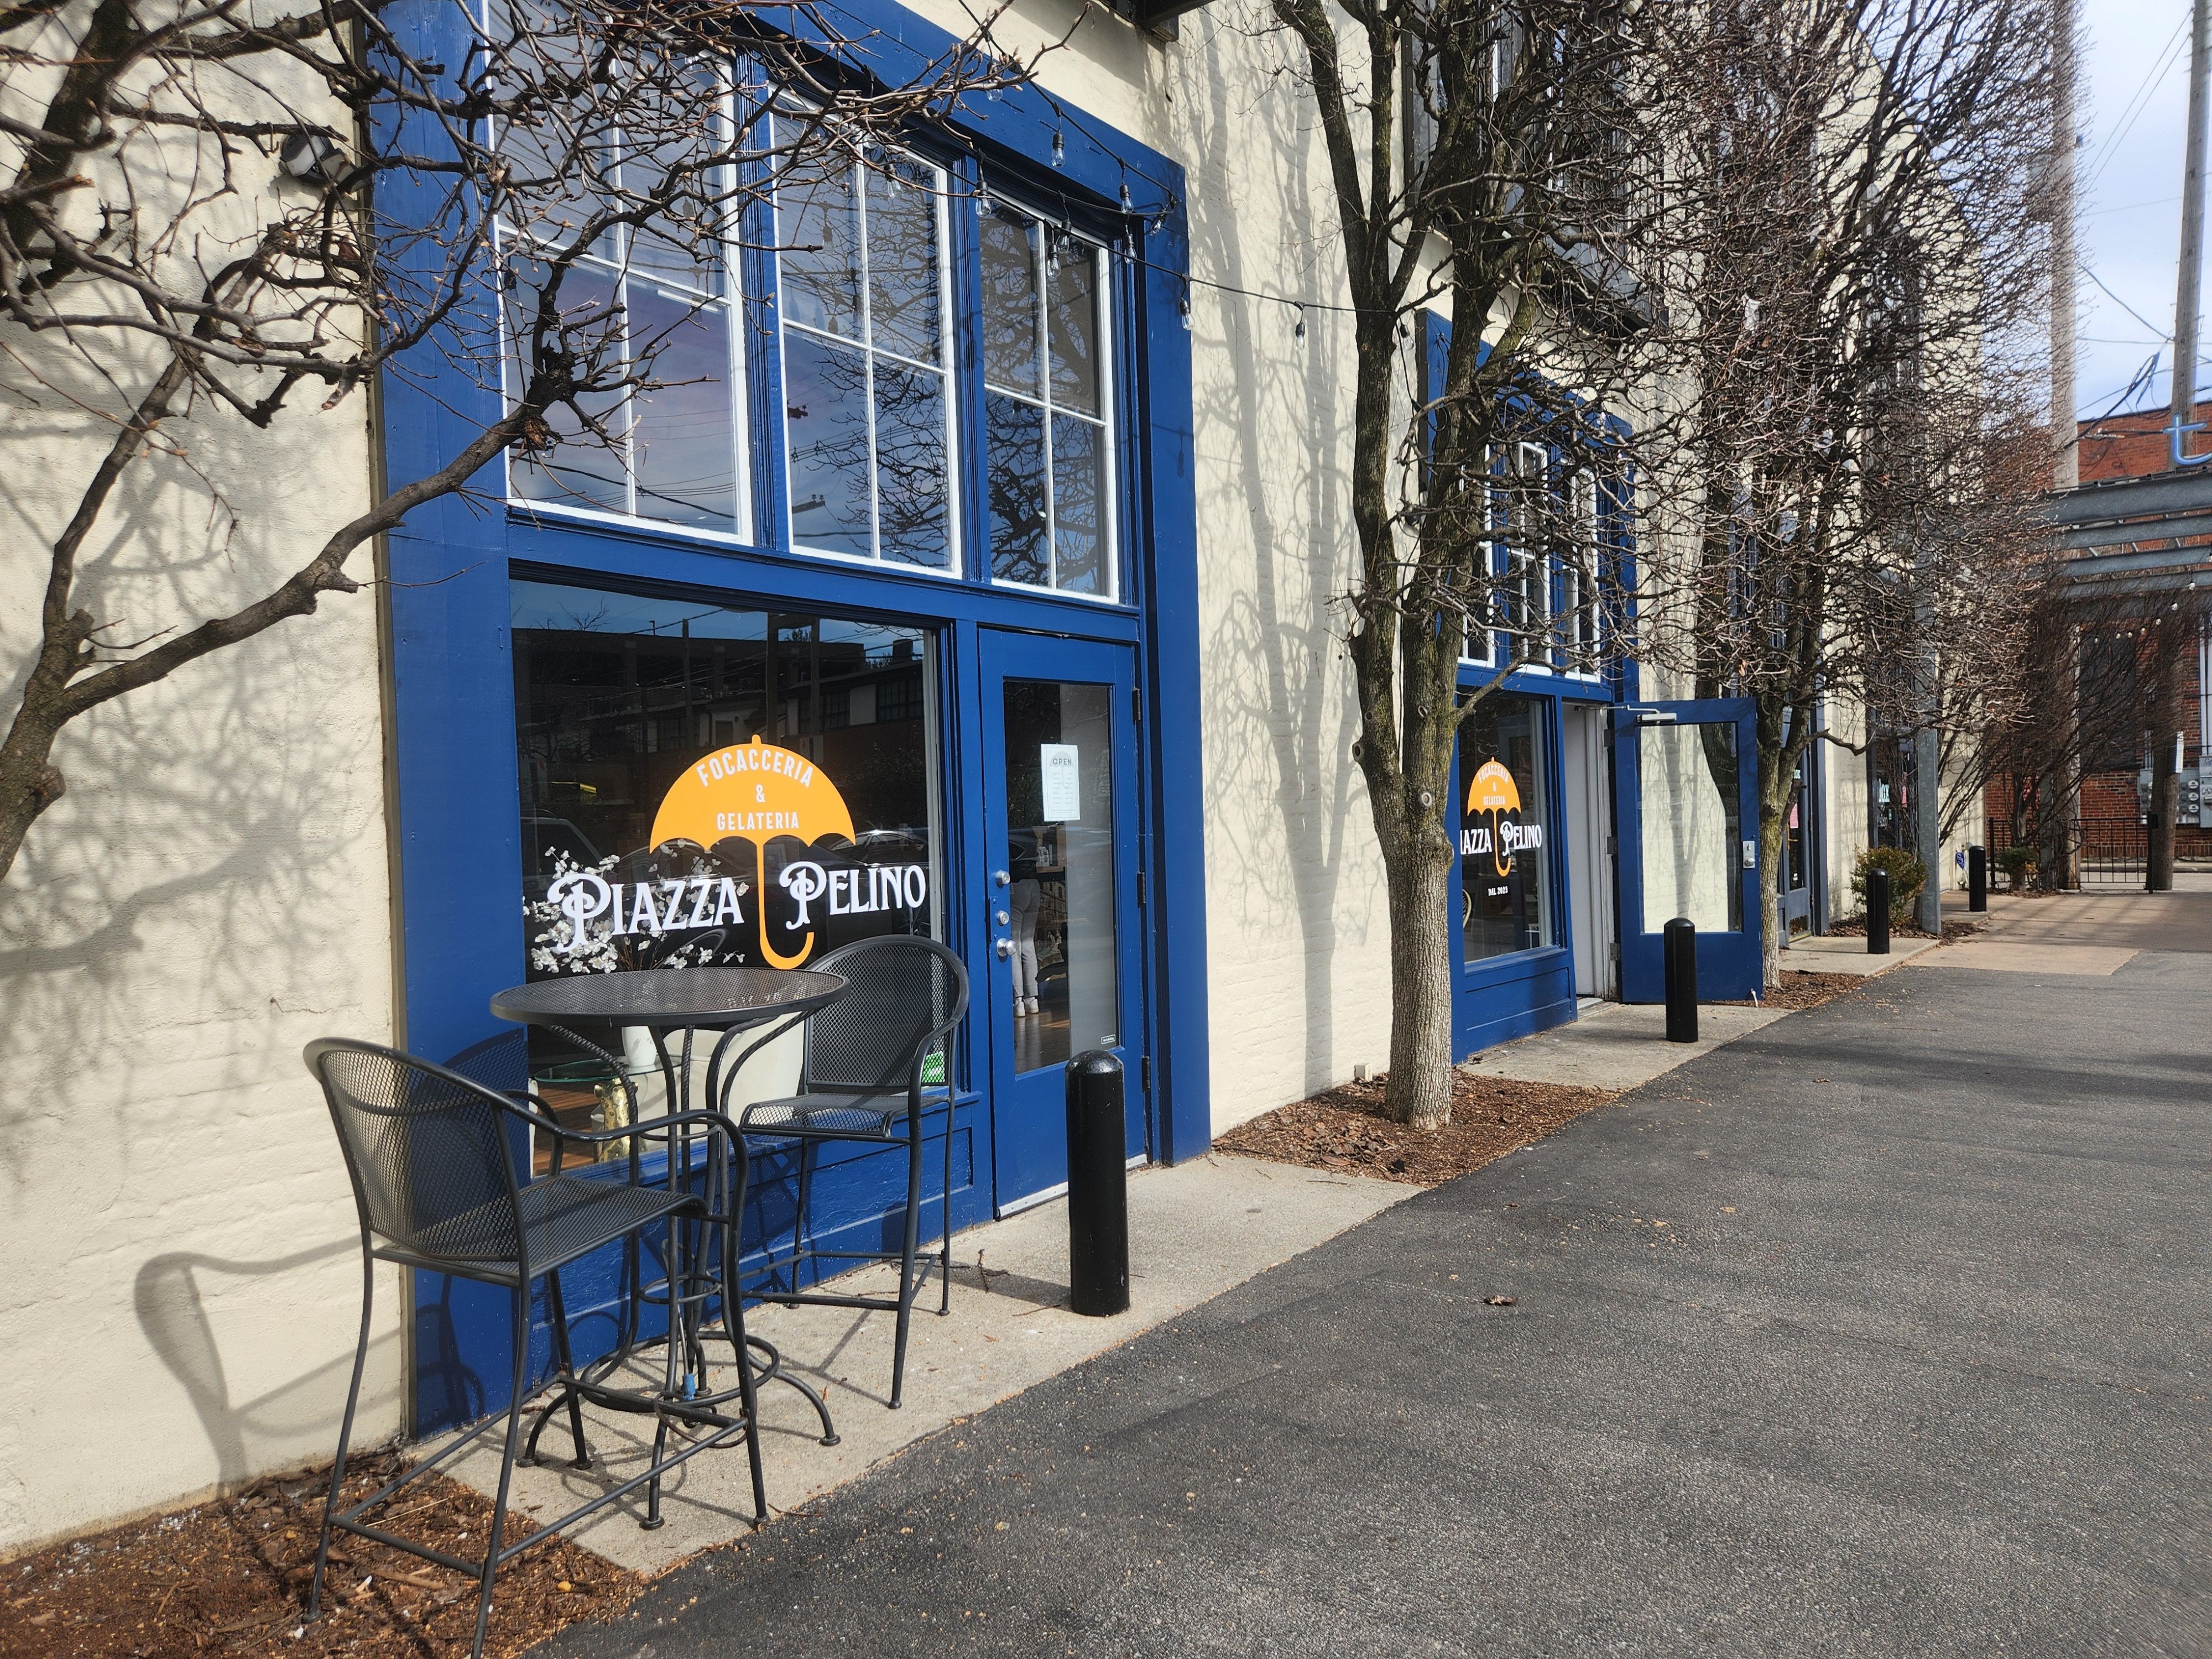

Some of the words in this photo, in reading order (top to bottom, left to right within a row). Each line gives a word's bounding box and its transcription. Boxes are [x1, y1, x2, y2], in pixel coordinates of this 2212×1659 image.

[696, 749, 813, 787] FOCACCERIA
[1478, 764, 1509, 784] FOCACCERIA
[756, 784, 765, 802] &
[1493, 781, 1496, 792] &
[1483, 796, 1506, 806] GELATERIA
[717, 812, 799, 831] GELATERIA
[1460, 828, 1492, 854] IAZZA
[1500, 821, 1542, 857] PELINO
[1498, 886, 1508, 895] 2023
[547, 873, 745, 953] PIAZZA
[779, 861, 926, 930] PELINO
